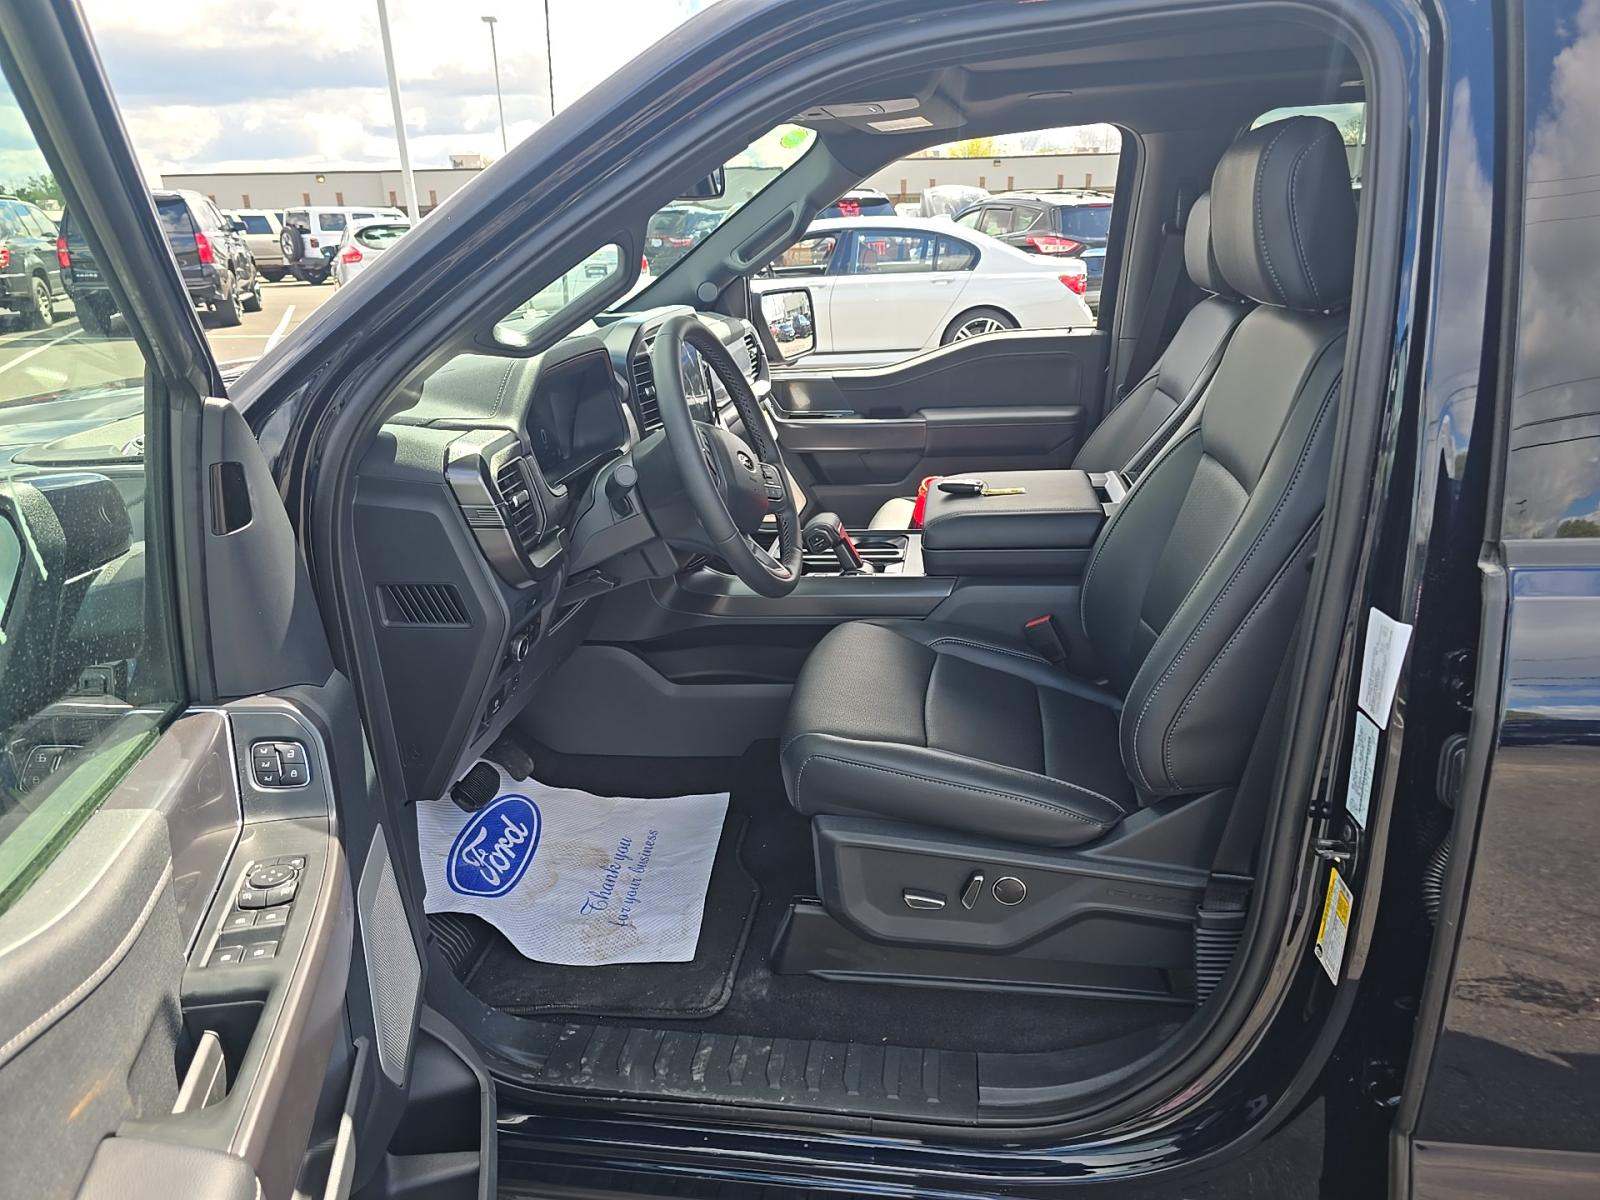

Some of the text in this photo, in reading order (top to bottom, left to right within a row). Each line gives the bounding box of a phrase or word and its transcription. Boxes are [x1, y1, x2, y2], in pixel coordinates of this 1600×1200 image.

[462, 813, 529, 886] Ford
[580, 836, 633, 915] Thank you
[608, 829, 658, 928] for your business
